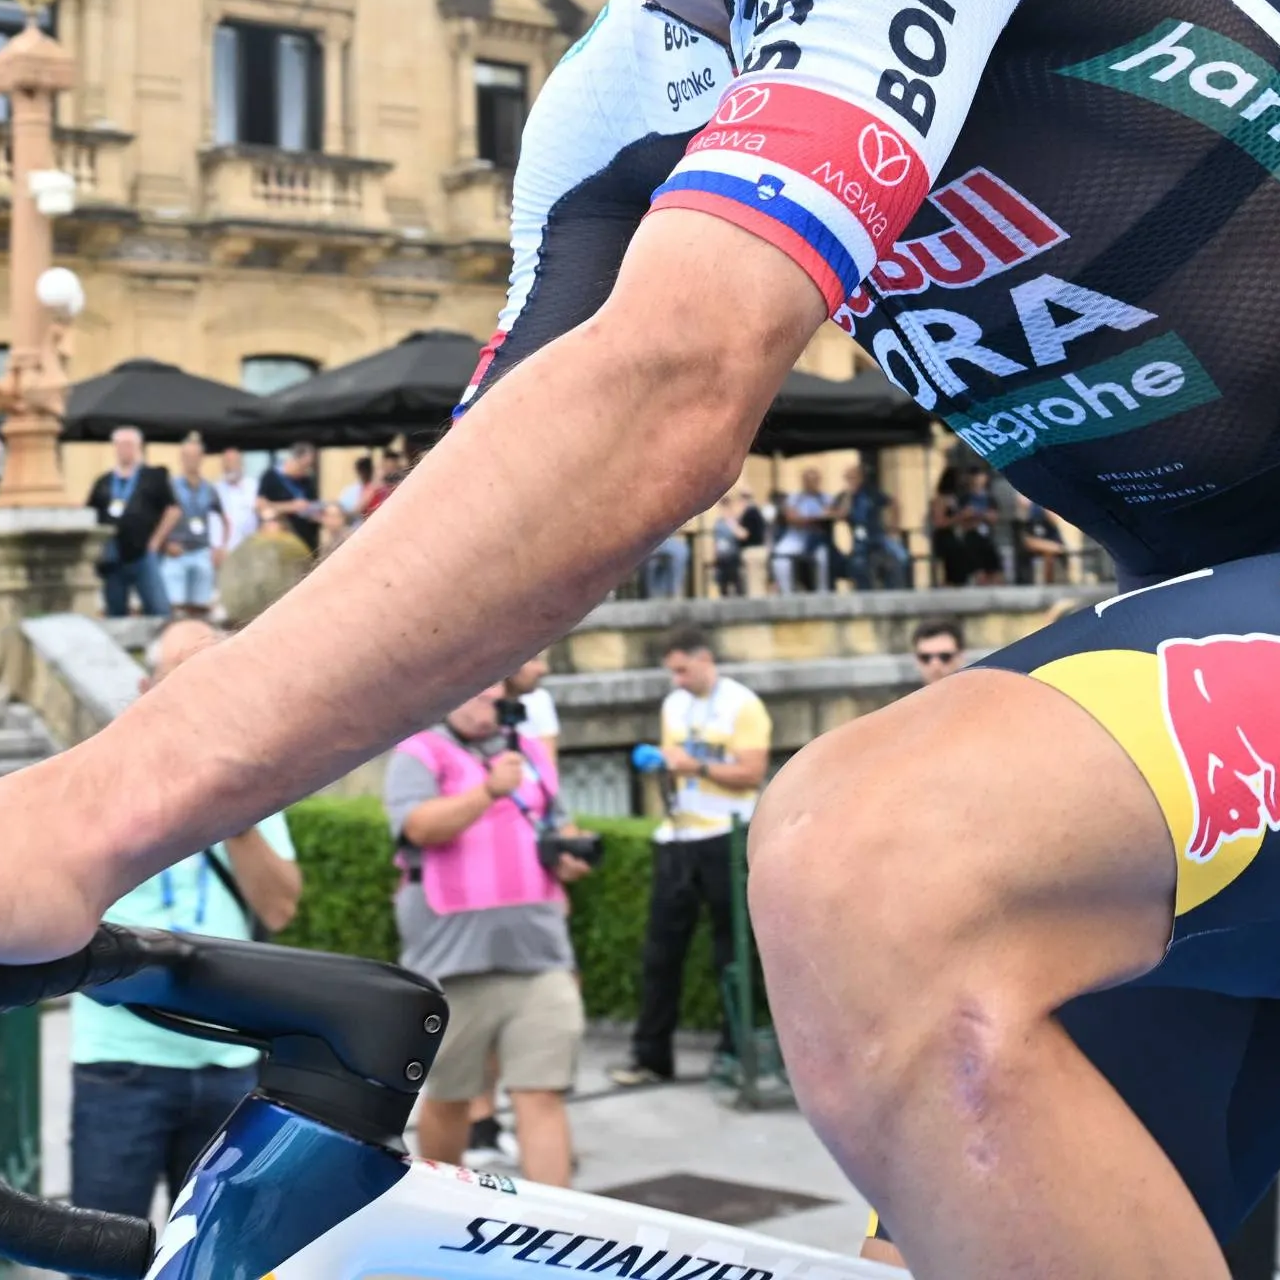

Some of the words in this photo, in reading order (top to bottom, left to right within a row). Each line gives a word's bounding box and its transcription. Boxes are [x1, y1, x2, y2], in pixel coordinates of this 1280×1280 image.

[667, 67, 715, 112] grenke
[873, 274, 1159, 410] ORA
[956, 360, 1185, 457] nsgrohe
